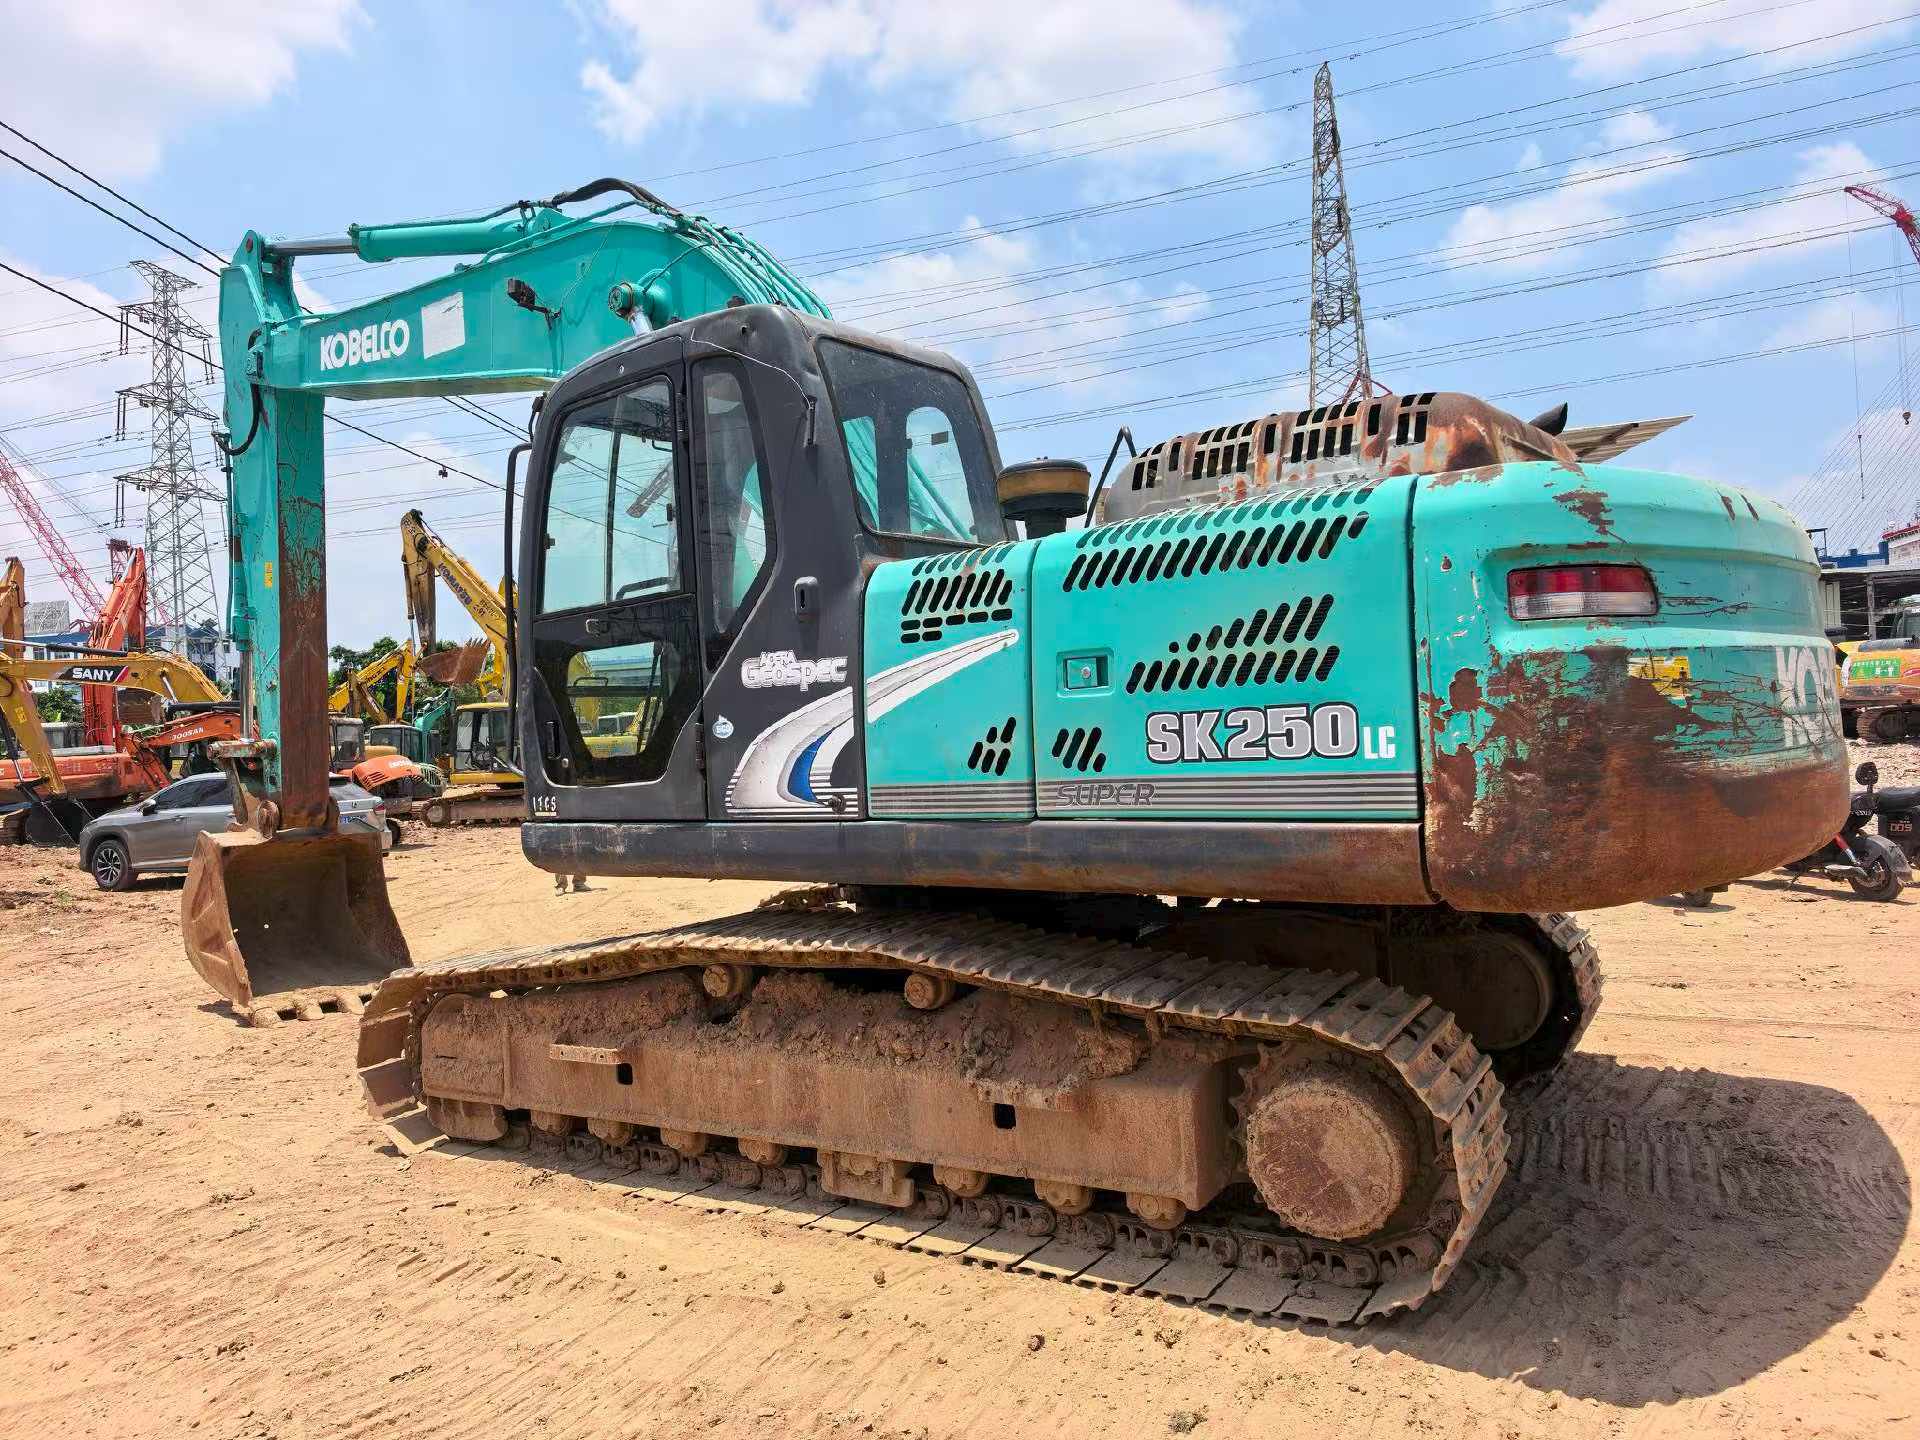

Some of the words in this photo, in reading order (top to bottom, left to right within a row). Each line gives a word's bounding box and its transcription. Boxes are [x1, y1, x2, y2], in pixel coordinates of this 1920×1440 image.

[320, 319, 410, 371] KOBELCO
[72, 667, 113, 681] SANY
[171, 726, 204, 741] DOOSAN
[1145, 701, 1359, 763] SK250
[1363, 726, 1396, 760] LC
[1056, 783, 1156, 807] SUPER
